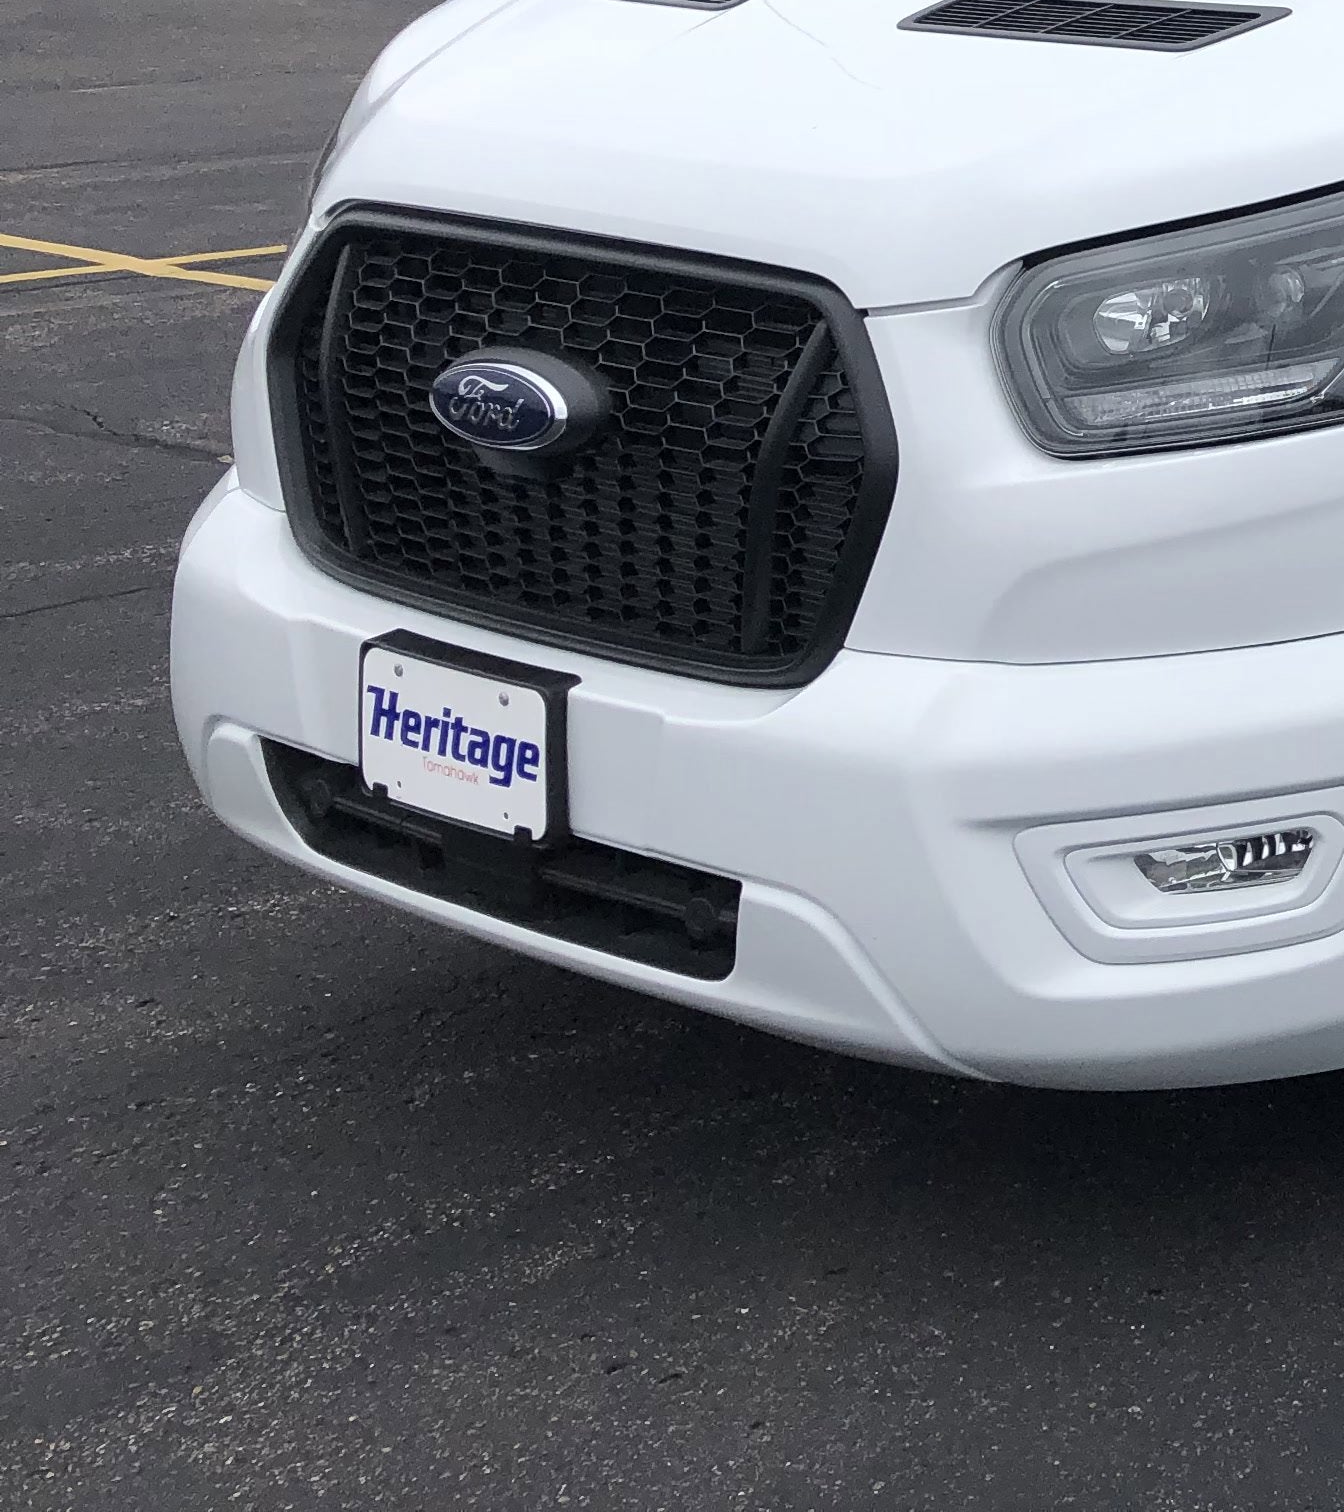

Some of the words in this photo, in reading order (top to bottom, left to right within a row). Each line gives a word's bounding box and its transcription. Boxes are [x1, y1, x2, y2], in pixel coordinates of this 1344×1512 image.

[448, 375, 525, 431] Ford
[366, 684, 540, 789] Heritage
[422, 755, 479, 785] Tomahawk
